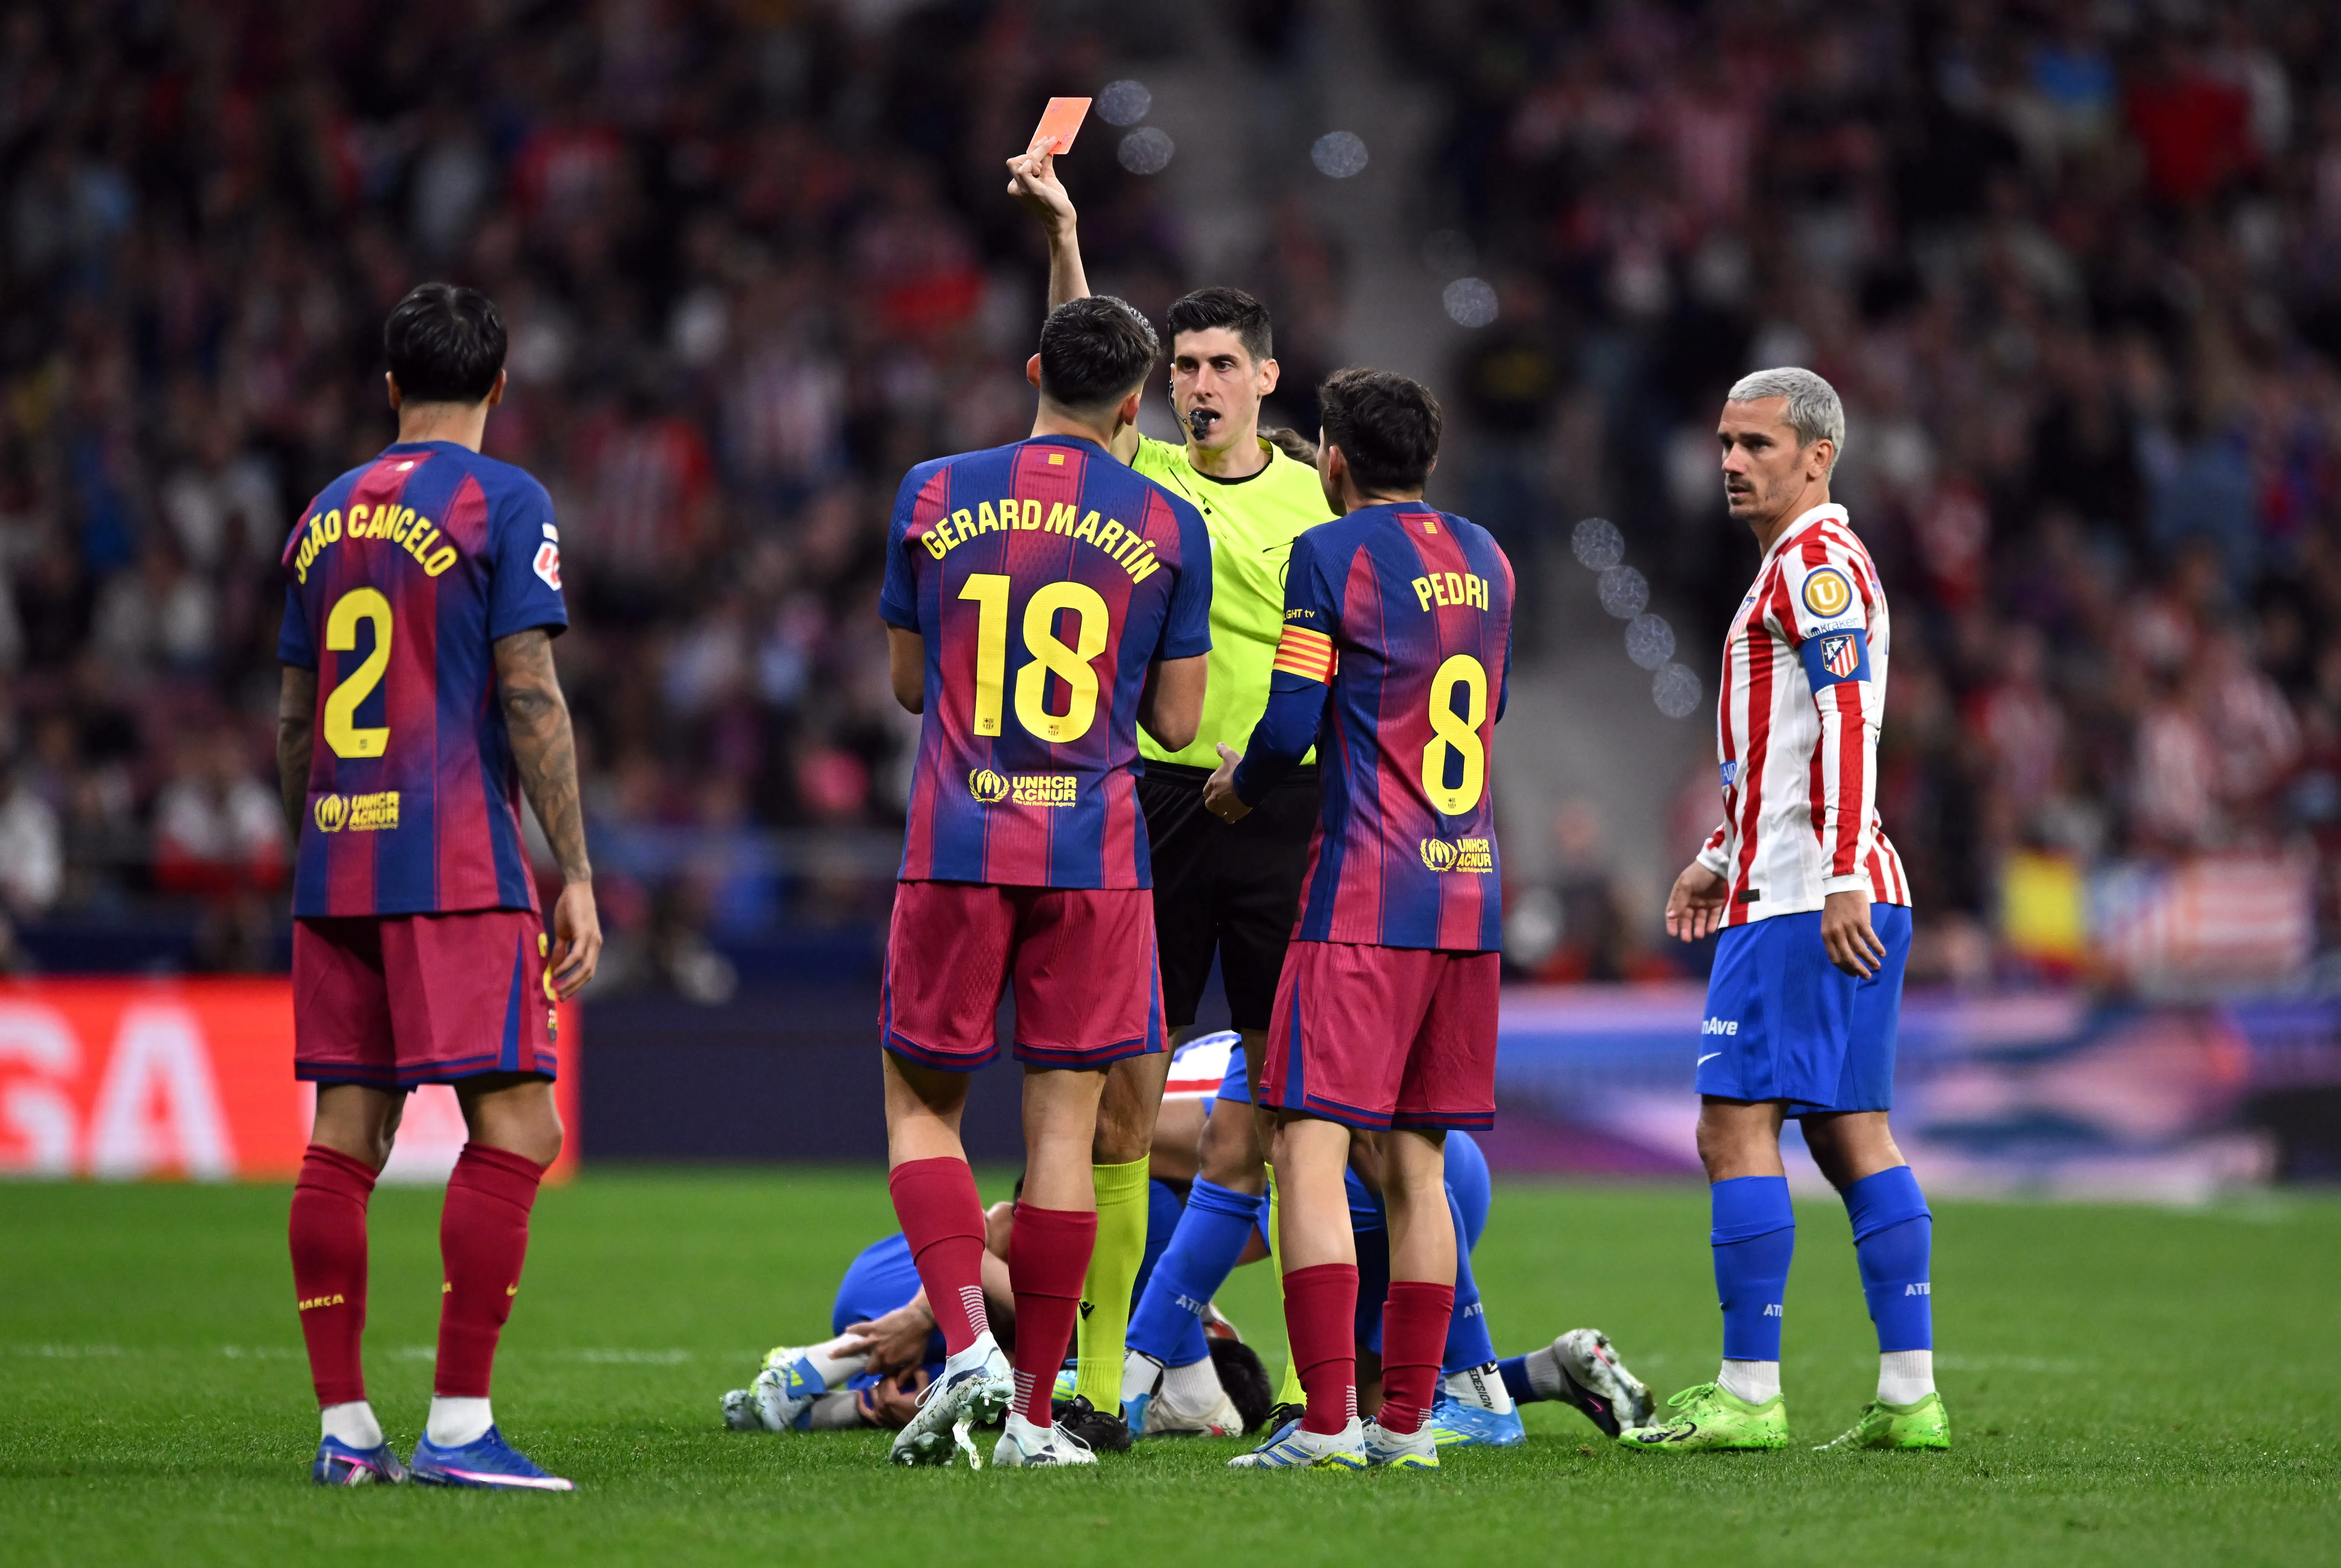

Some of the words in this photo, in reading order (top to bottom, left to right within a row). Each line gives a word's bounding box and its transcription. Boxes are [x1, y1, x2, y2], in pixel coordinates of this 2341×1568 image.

[295, 509, 341, 584] JOÃO
[347, 504, 457, 577] CANCELO
[921, 499, 1041, 560] GERARD
[1046, 502, 1161, 584] MARTÍN
[1411, 572, 1488, 612] PEDRI
[1304, 609, 1315, 618] tv
[324, 587, 393, 758] 2
[958, 573, 1109, 743] 18
[1421, 654, 1487, 816] 8
[1012, 776, 1077, 789] UNHCR
[1012, 789, 1076, 801] ACNUR
[1457, 838, 1490, 852] UNHCR
[1457, 853, 1492, 867] ACNUR
